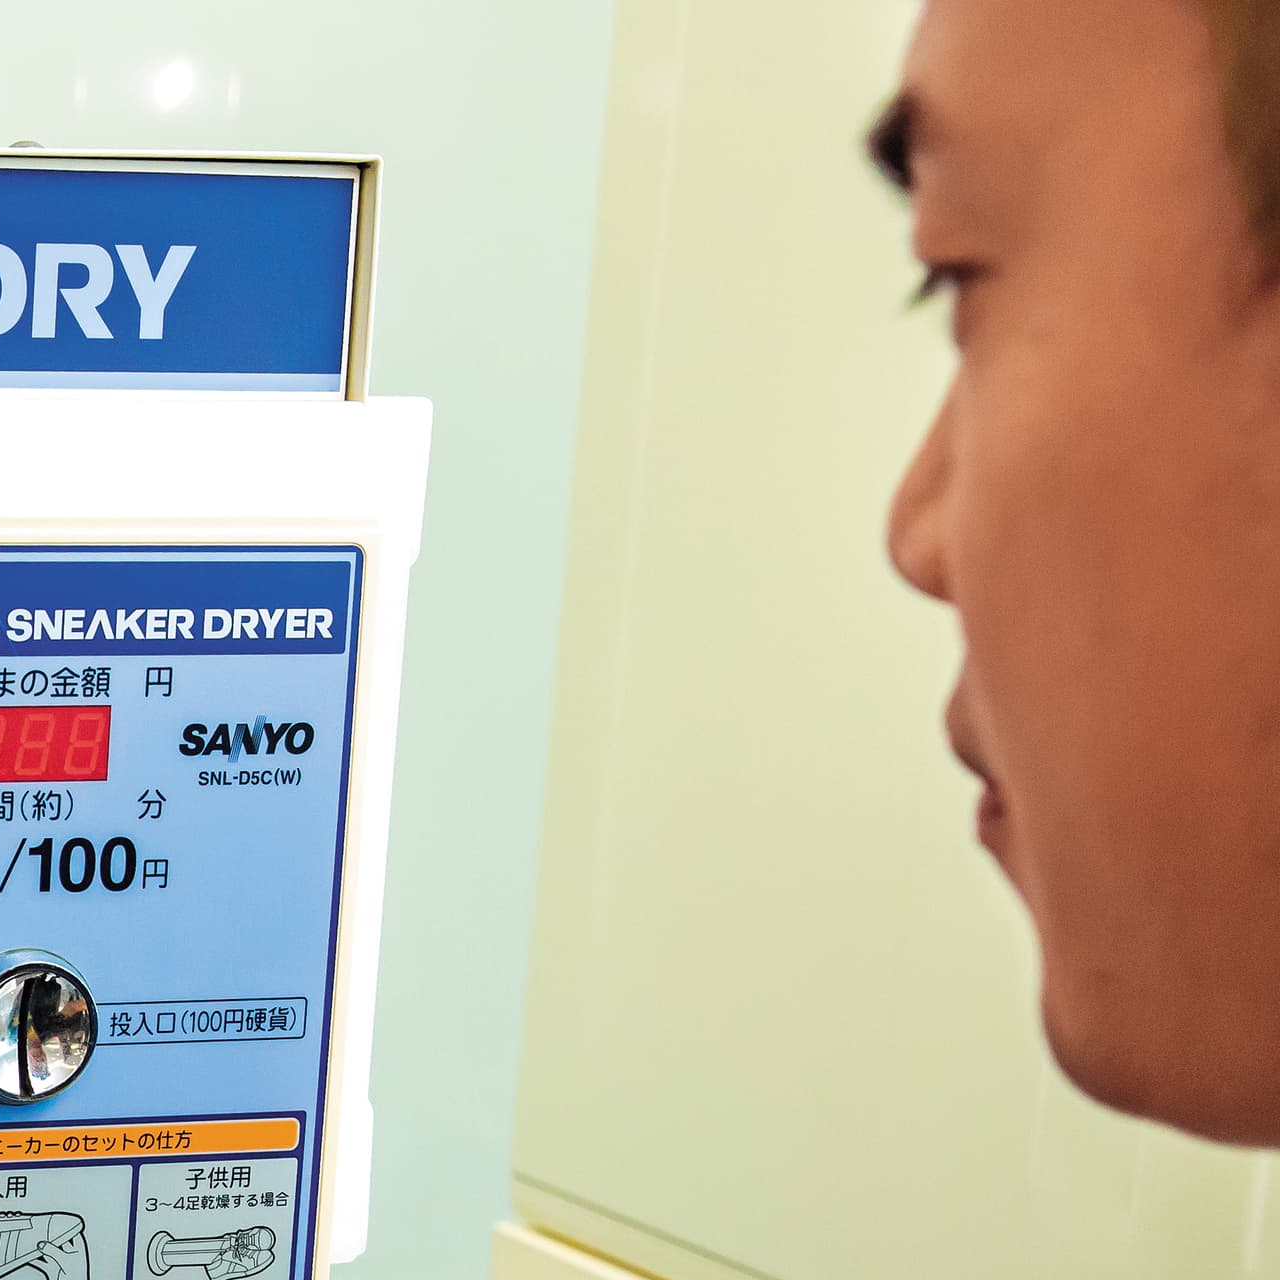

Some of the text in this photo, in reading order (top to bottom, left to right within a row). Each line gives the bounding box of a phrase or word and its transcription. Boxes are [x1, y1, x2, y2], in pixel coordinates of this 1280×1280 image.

[6, 608, 194, 641] SNEAKER
[203, 608, 333, 639] DRYER
[145, 667, 173, 698] 円
[179, 715, 314, 762] SANYO
[198, 767, 301, 787] SNL-D5C(W)
[137, 790, 167, 819] 分
[109, 1006, 297, 1038] 投入口(100円硬貨)
[185, 1166, 251, 1190] 子供用
